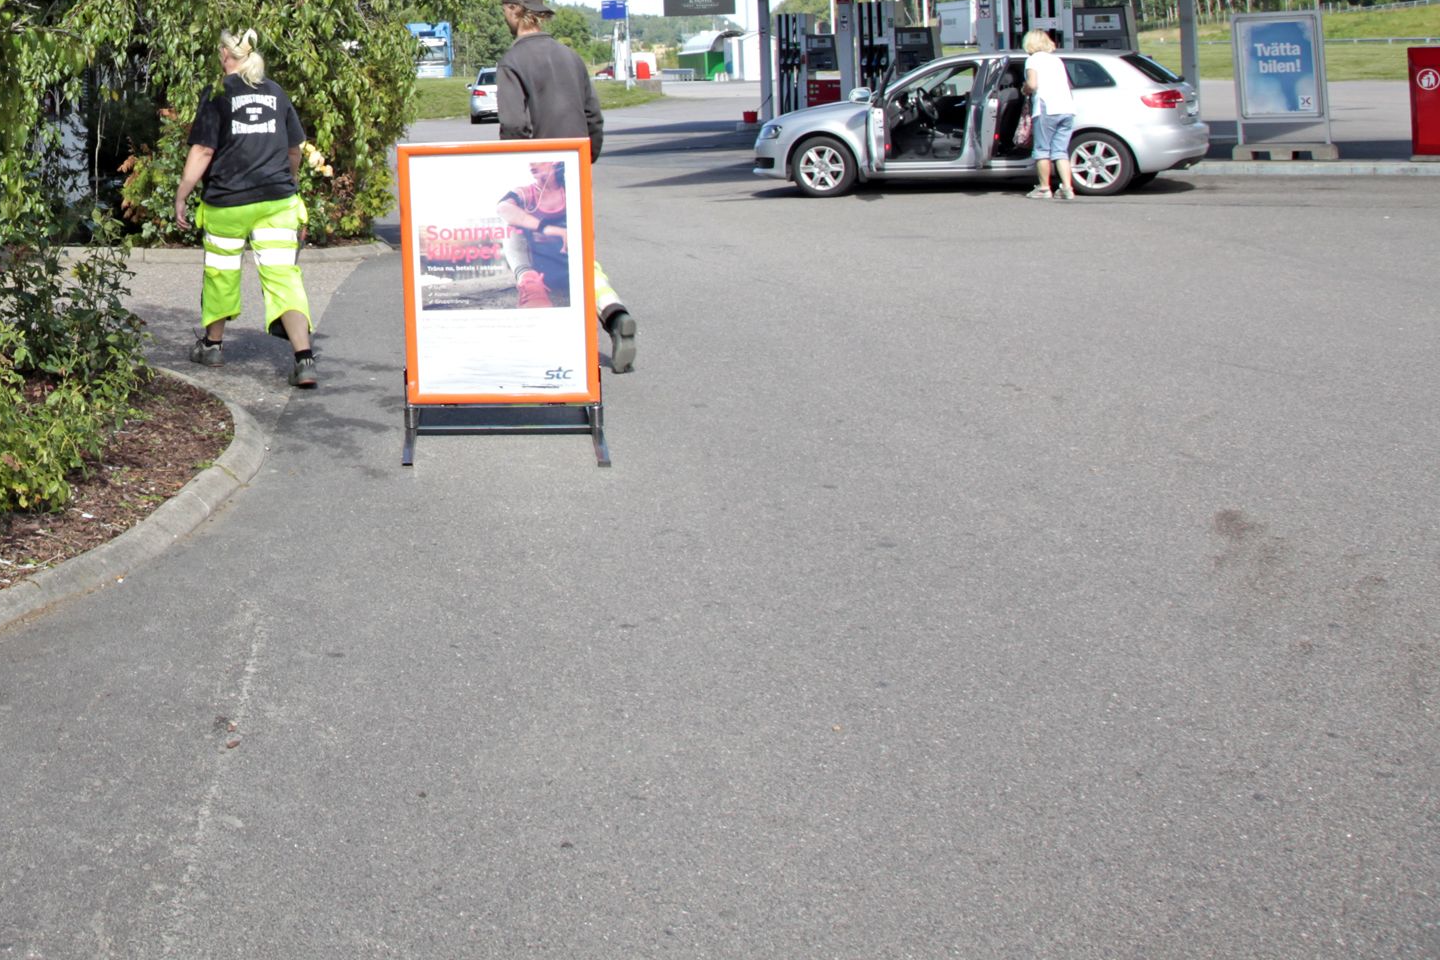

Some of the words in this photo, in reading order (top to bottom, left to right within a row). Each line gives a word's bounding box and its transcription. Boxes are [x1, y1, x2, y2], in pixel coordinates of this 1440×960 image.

[1254, 42, 1301, 57] Tvätta
[1259, 59, 1301, 73] bilen!
[426, 225, 524, 241] Sommar-
[426, 242, 503, 264] klippet
[544, 366, 573, 380] stc
